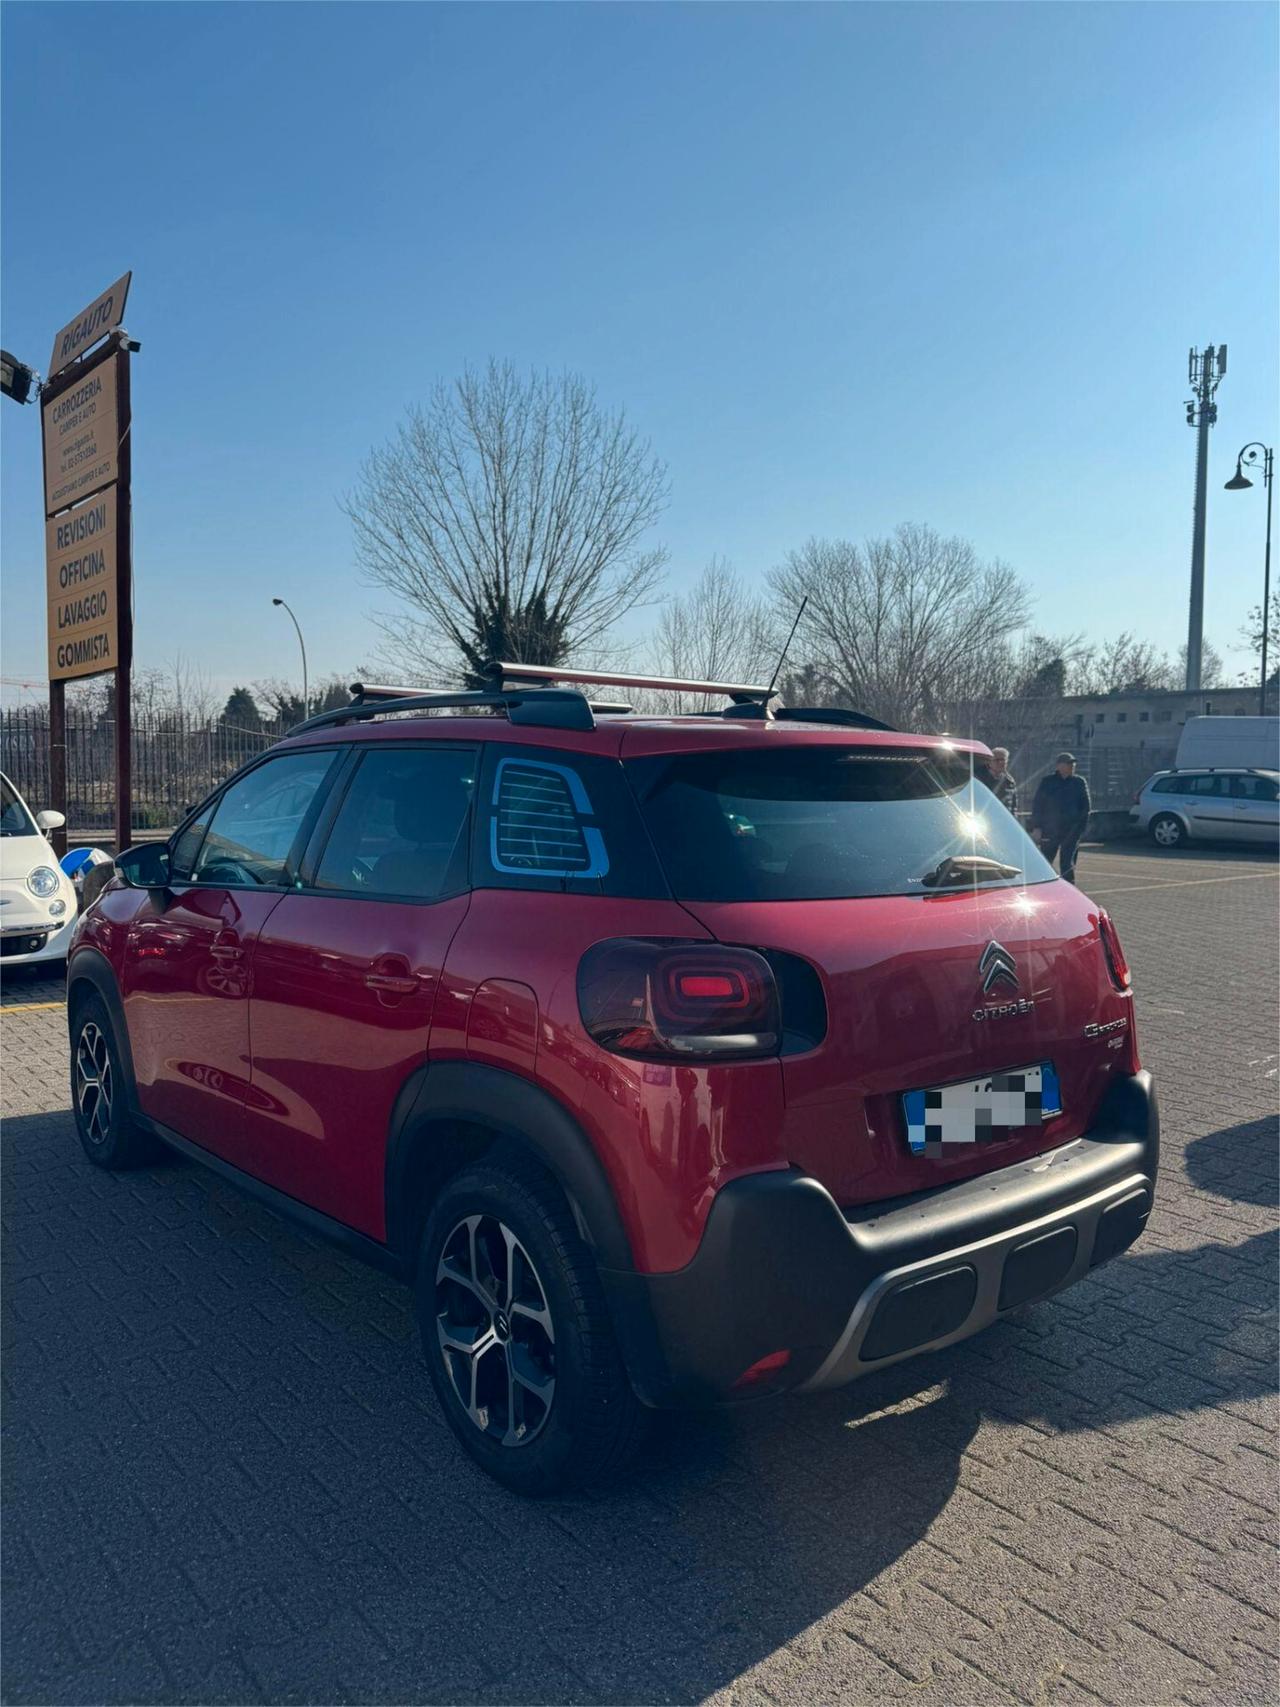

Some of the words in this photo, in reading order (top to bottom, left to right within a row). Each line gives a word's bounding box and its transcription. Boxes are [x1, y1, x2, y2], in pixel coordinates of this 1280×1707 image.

[60, 296, 113, 358] RIGAUTO
[53, 376, 102, 424] CARROZZERIA
[59, 414, 79, 436] CAMPER
[83, 402, 97, 419] AUTO
[78, 469, 95, 487] CAMPER
[99, 461, 111, 476] AUTO
[57, 503, 106, 550] REVISIONI
[59, 547, 106, 589] OFFICINA
[57, 589, 107, 629] LAVAGGIO
[56, 632, 110, 668] GOMMISTA
